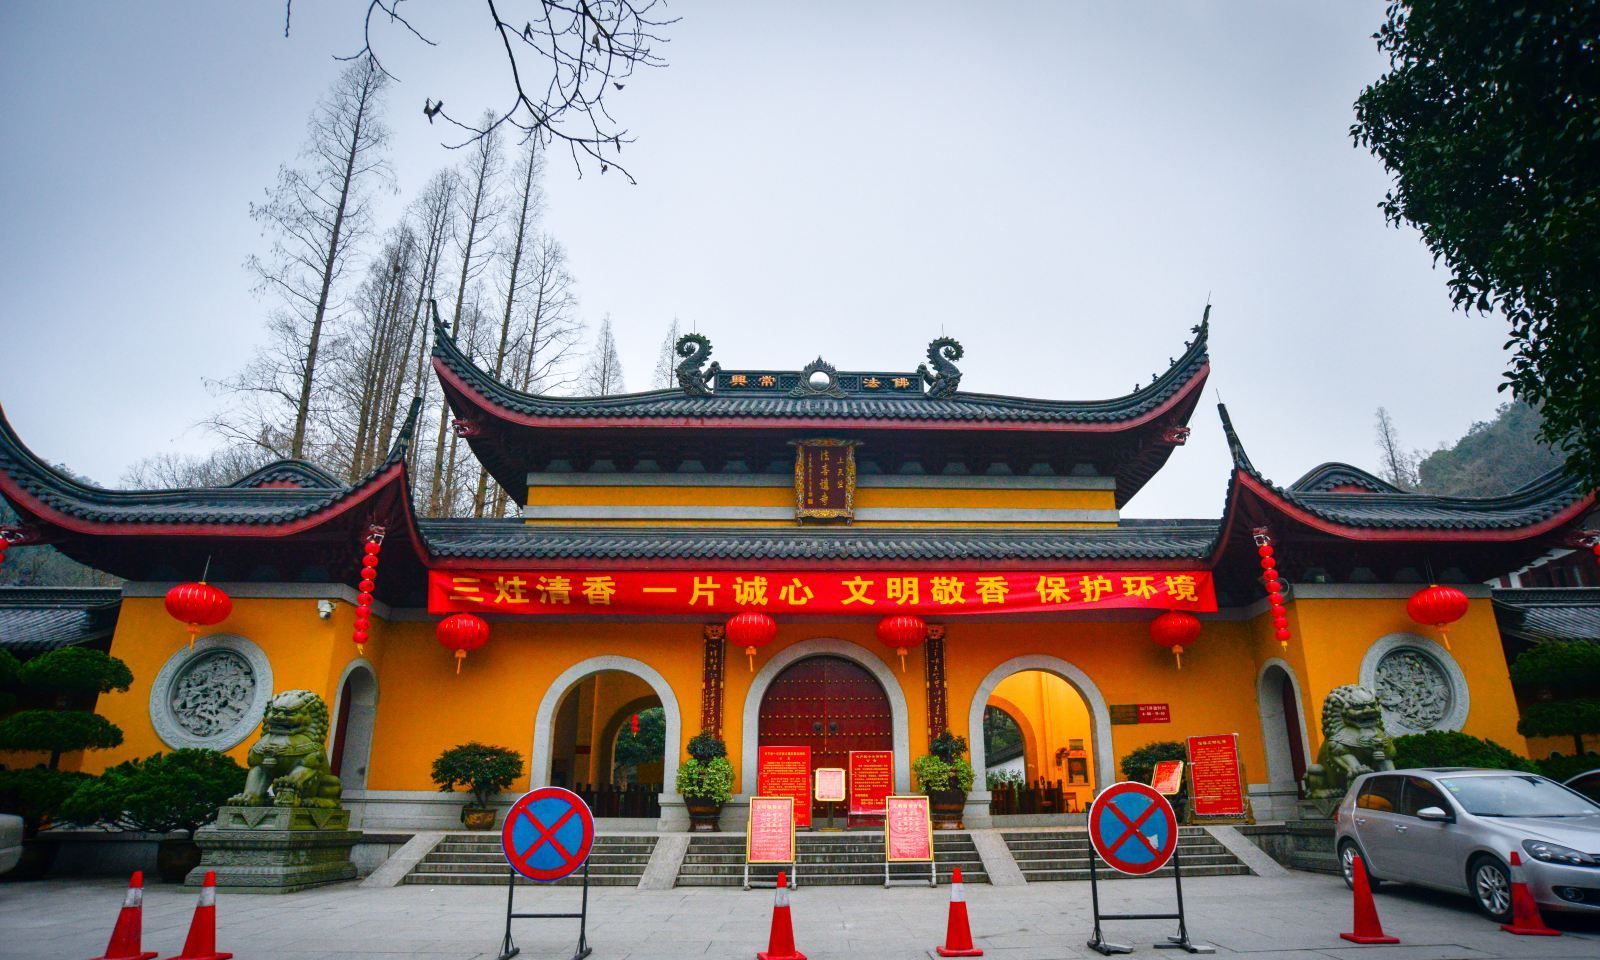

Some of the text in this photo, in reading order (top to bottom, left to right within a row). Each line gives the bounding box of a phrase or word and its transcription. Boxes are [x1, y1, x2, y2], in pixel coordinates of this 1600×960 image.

[449, 574, 1200, 606] 三炷清香 一片诚心 文明敬香 保护环境
